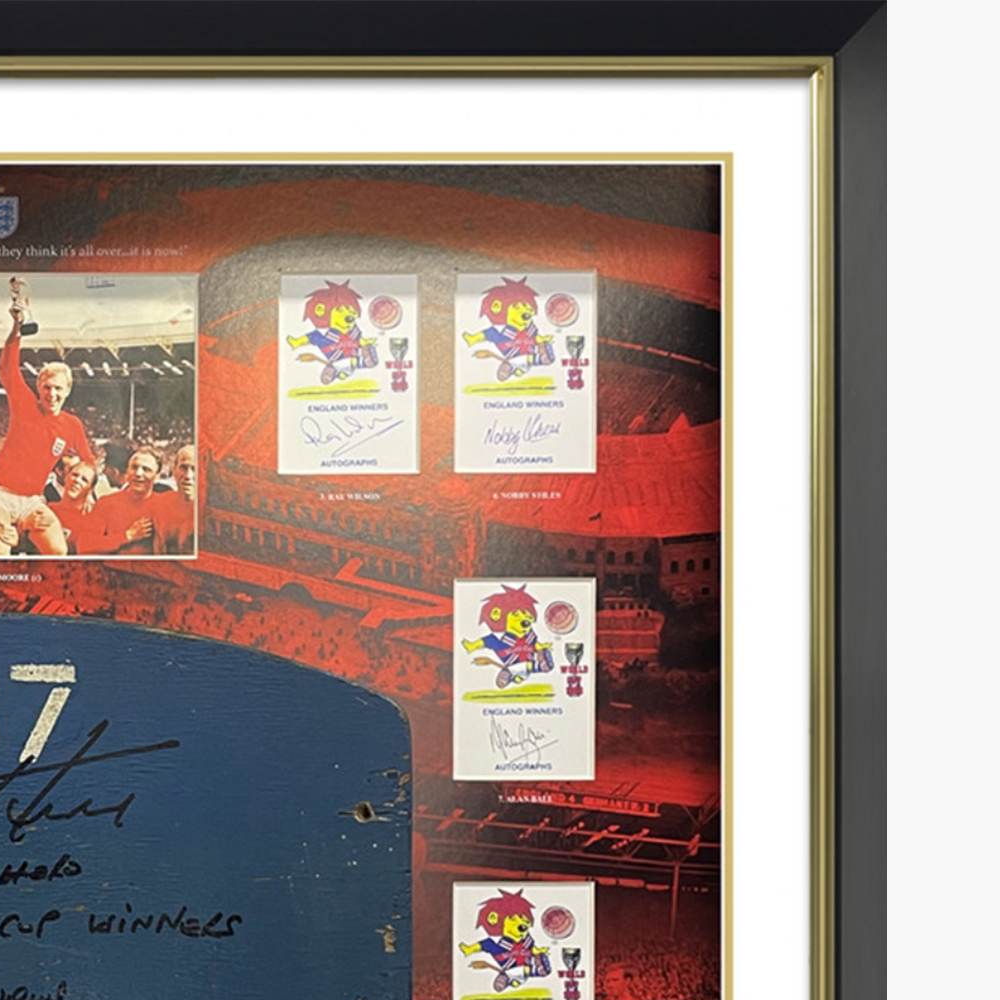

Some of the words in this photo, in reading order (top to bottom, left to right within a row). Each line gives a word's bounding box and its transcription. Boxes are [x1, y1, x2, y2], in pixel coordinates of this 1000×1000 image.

[25, 245, 57, 257] think
[78, 245, 94, 257] all
[141, 245, 151, 257] is
[307, 404, 348, 413] ENGLAND
[350, 404, 389, 413] WINNERS
[483, 400, 524, 409] ENGLAND
[526, 400, 565, 409] WINNERS
[320, 460, 379, 468] AUTOGRAPHS
[495, 457, 554, 465] AUTOGRAPHS
[482, 707, 523, 716] ENGLAND
[525, 707, 564, 716] WINNERS
[494, 763, 553, 771] AUTOGRAPHS
[88, 903, 243, 938] WINNERS
